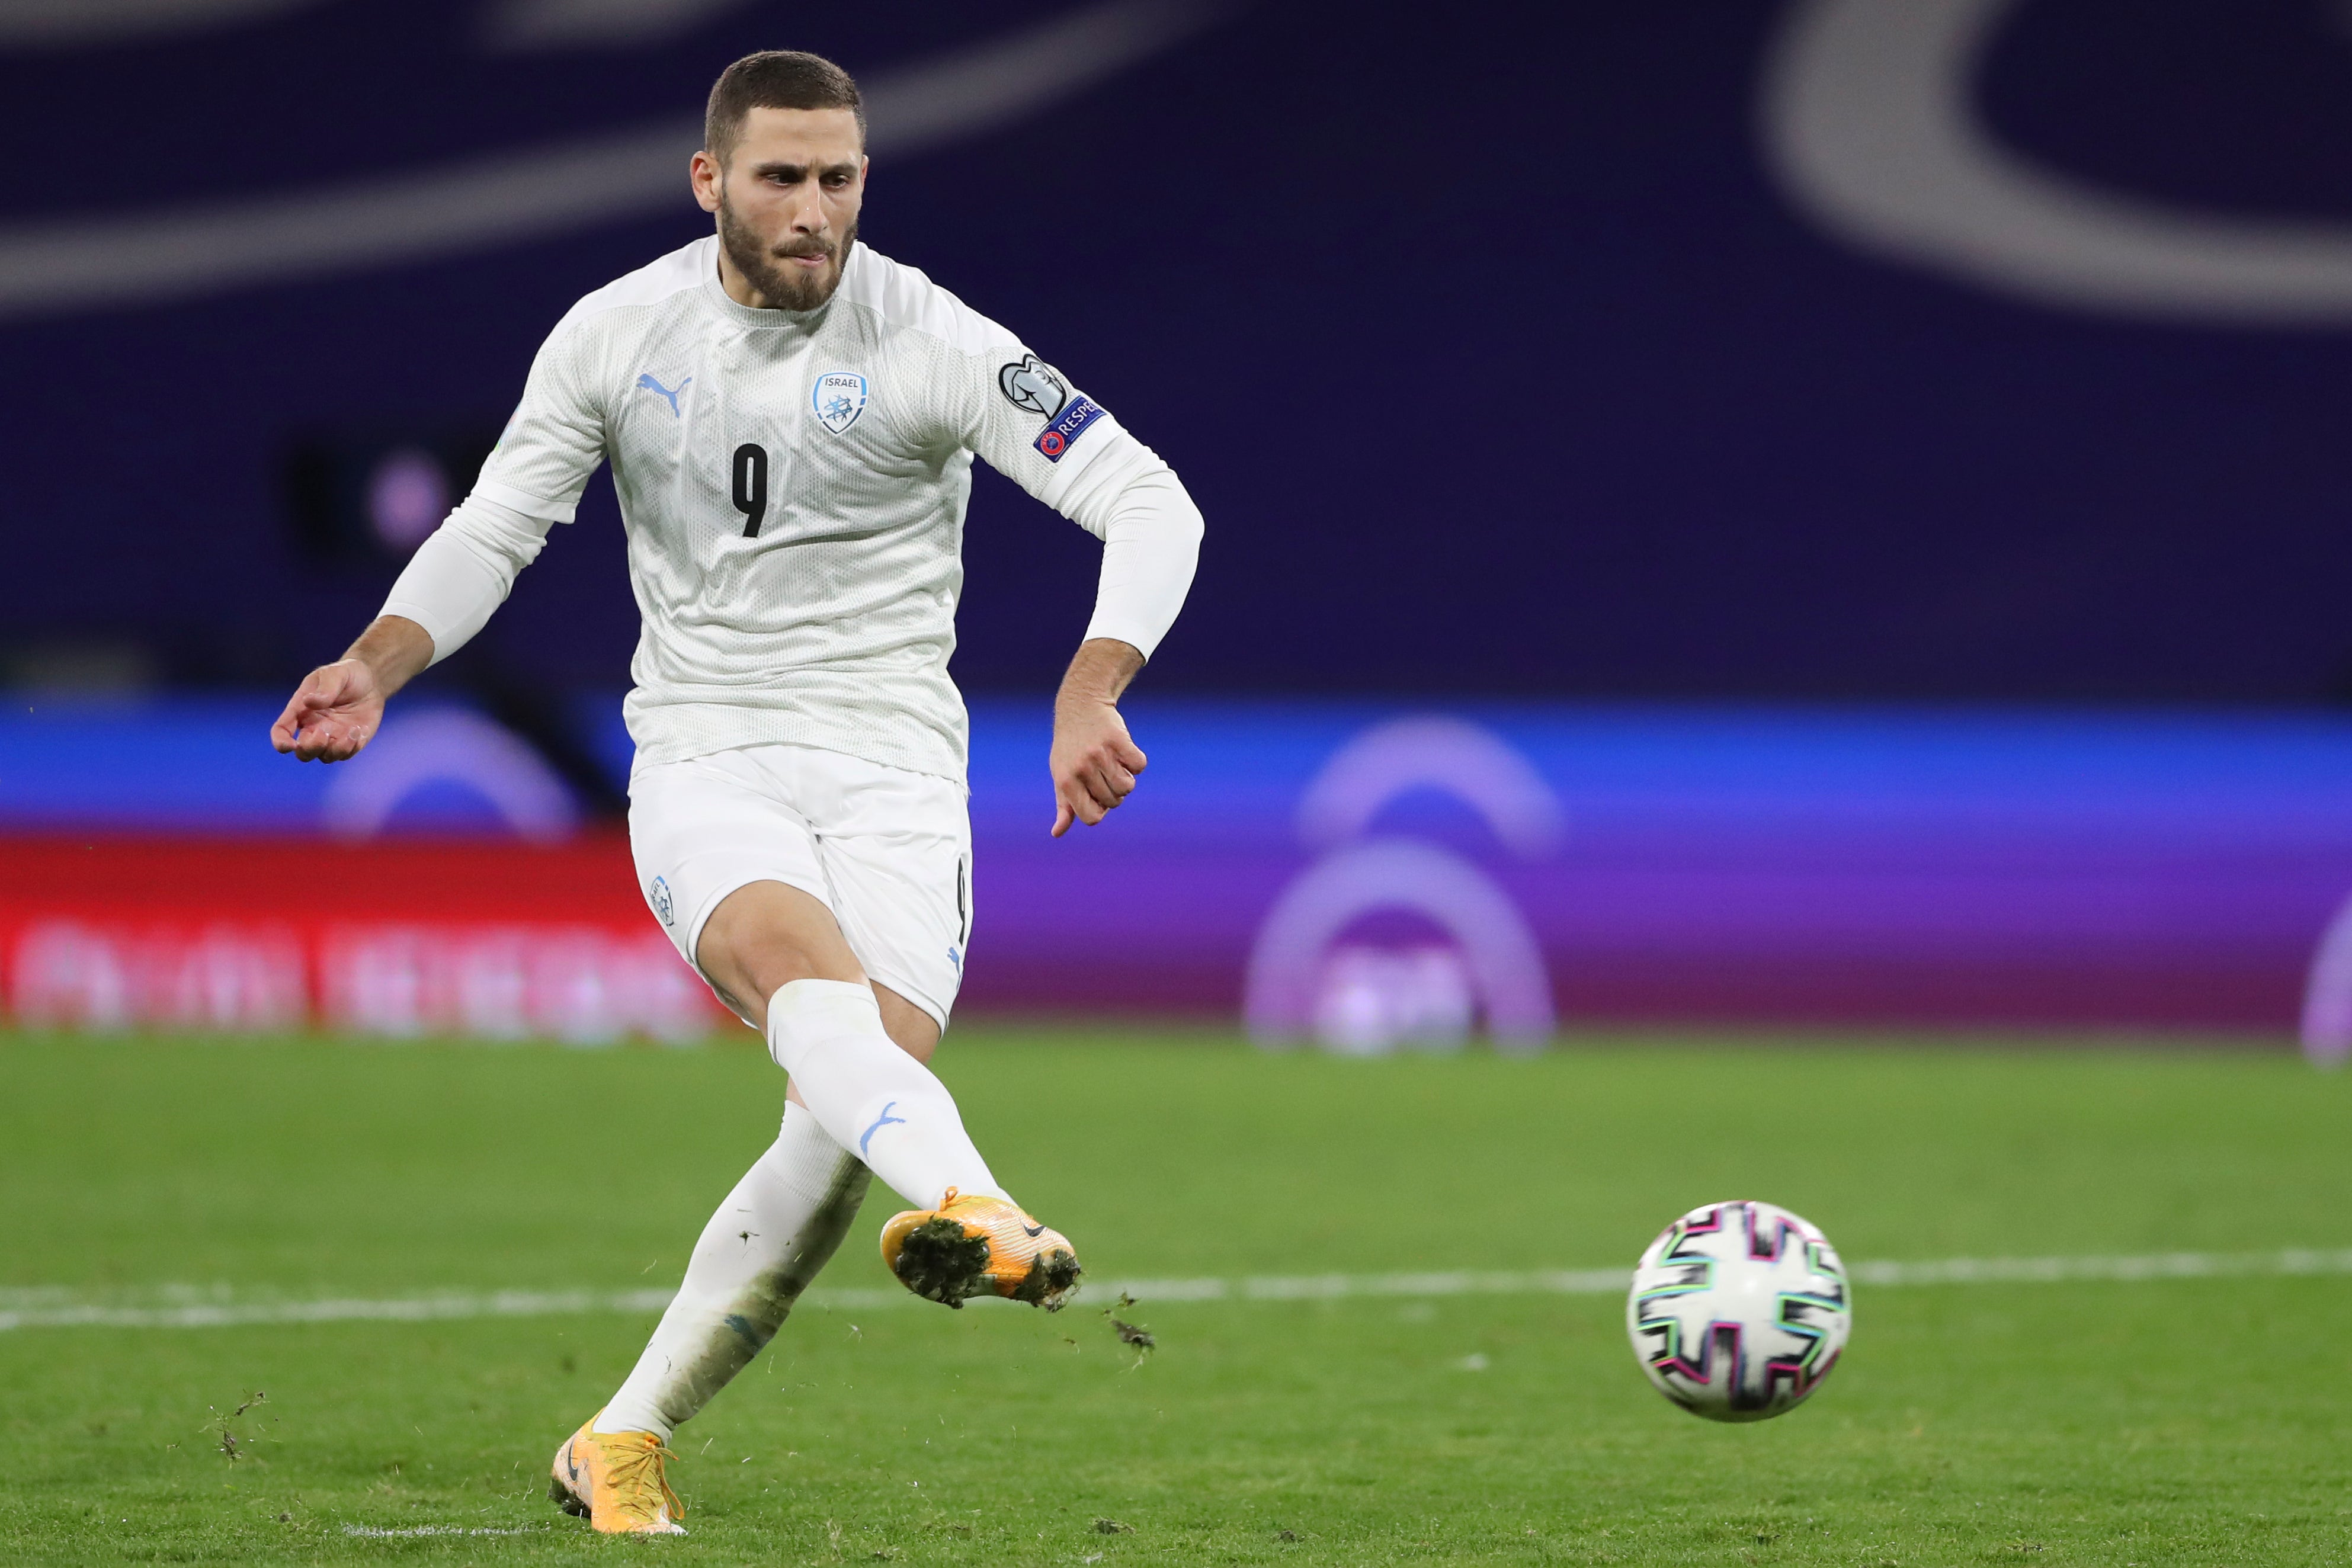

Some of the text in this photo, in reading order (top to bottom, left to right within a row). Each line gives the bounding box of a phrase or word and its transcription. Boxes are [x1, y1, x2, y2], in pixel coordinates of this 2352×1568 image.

[825, 377, 858, 388] ISRAEL
[1058, 401, 1098, 436] RESPE
[732, 442, 768, 538] 9
